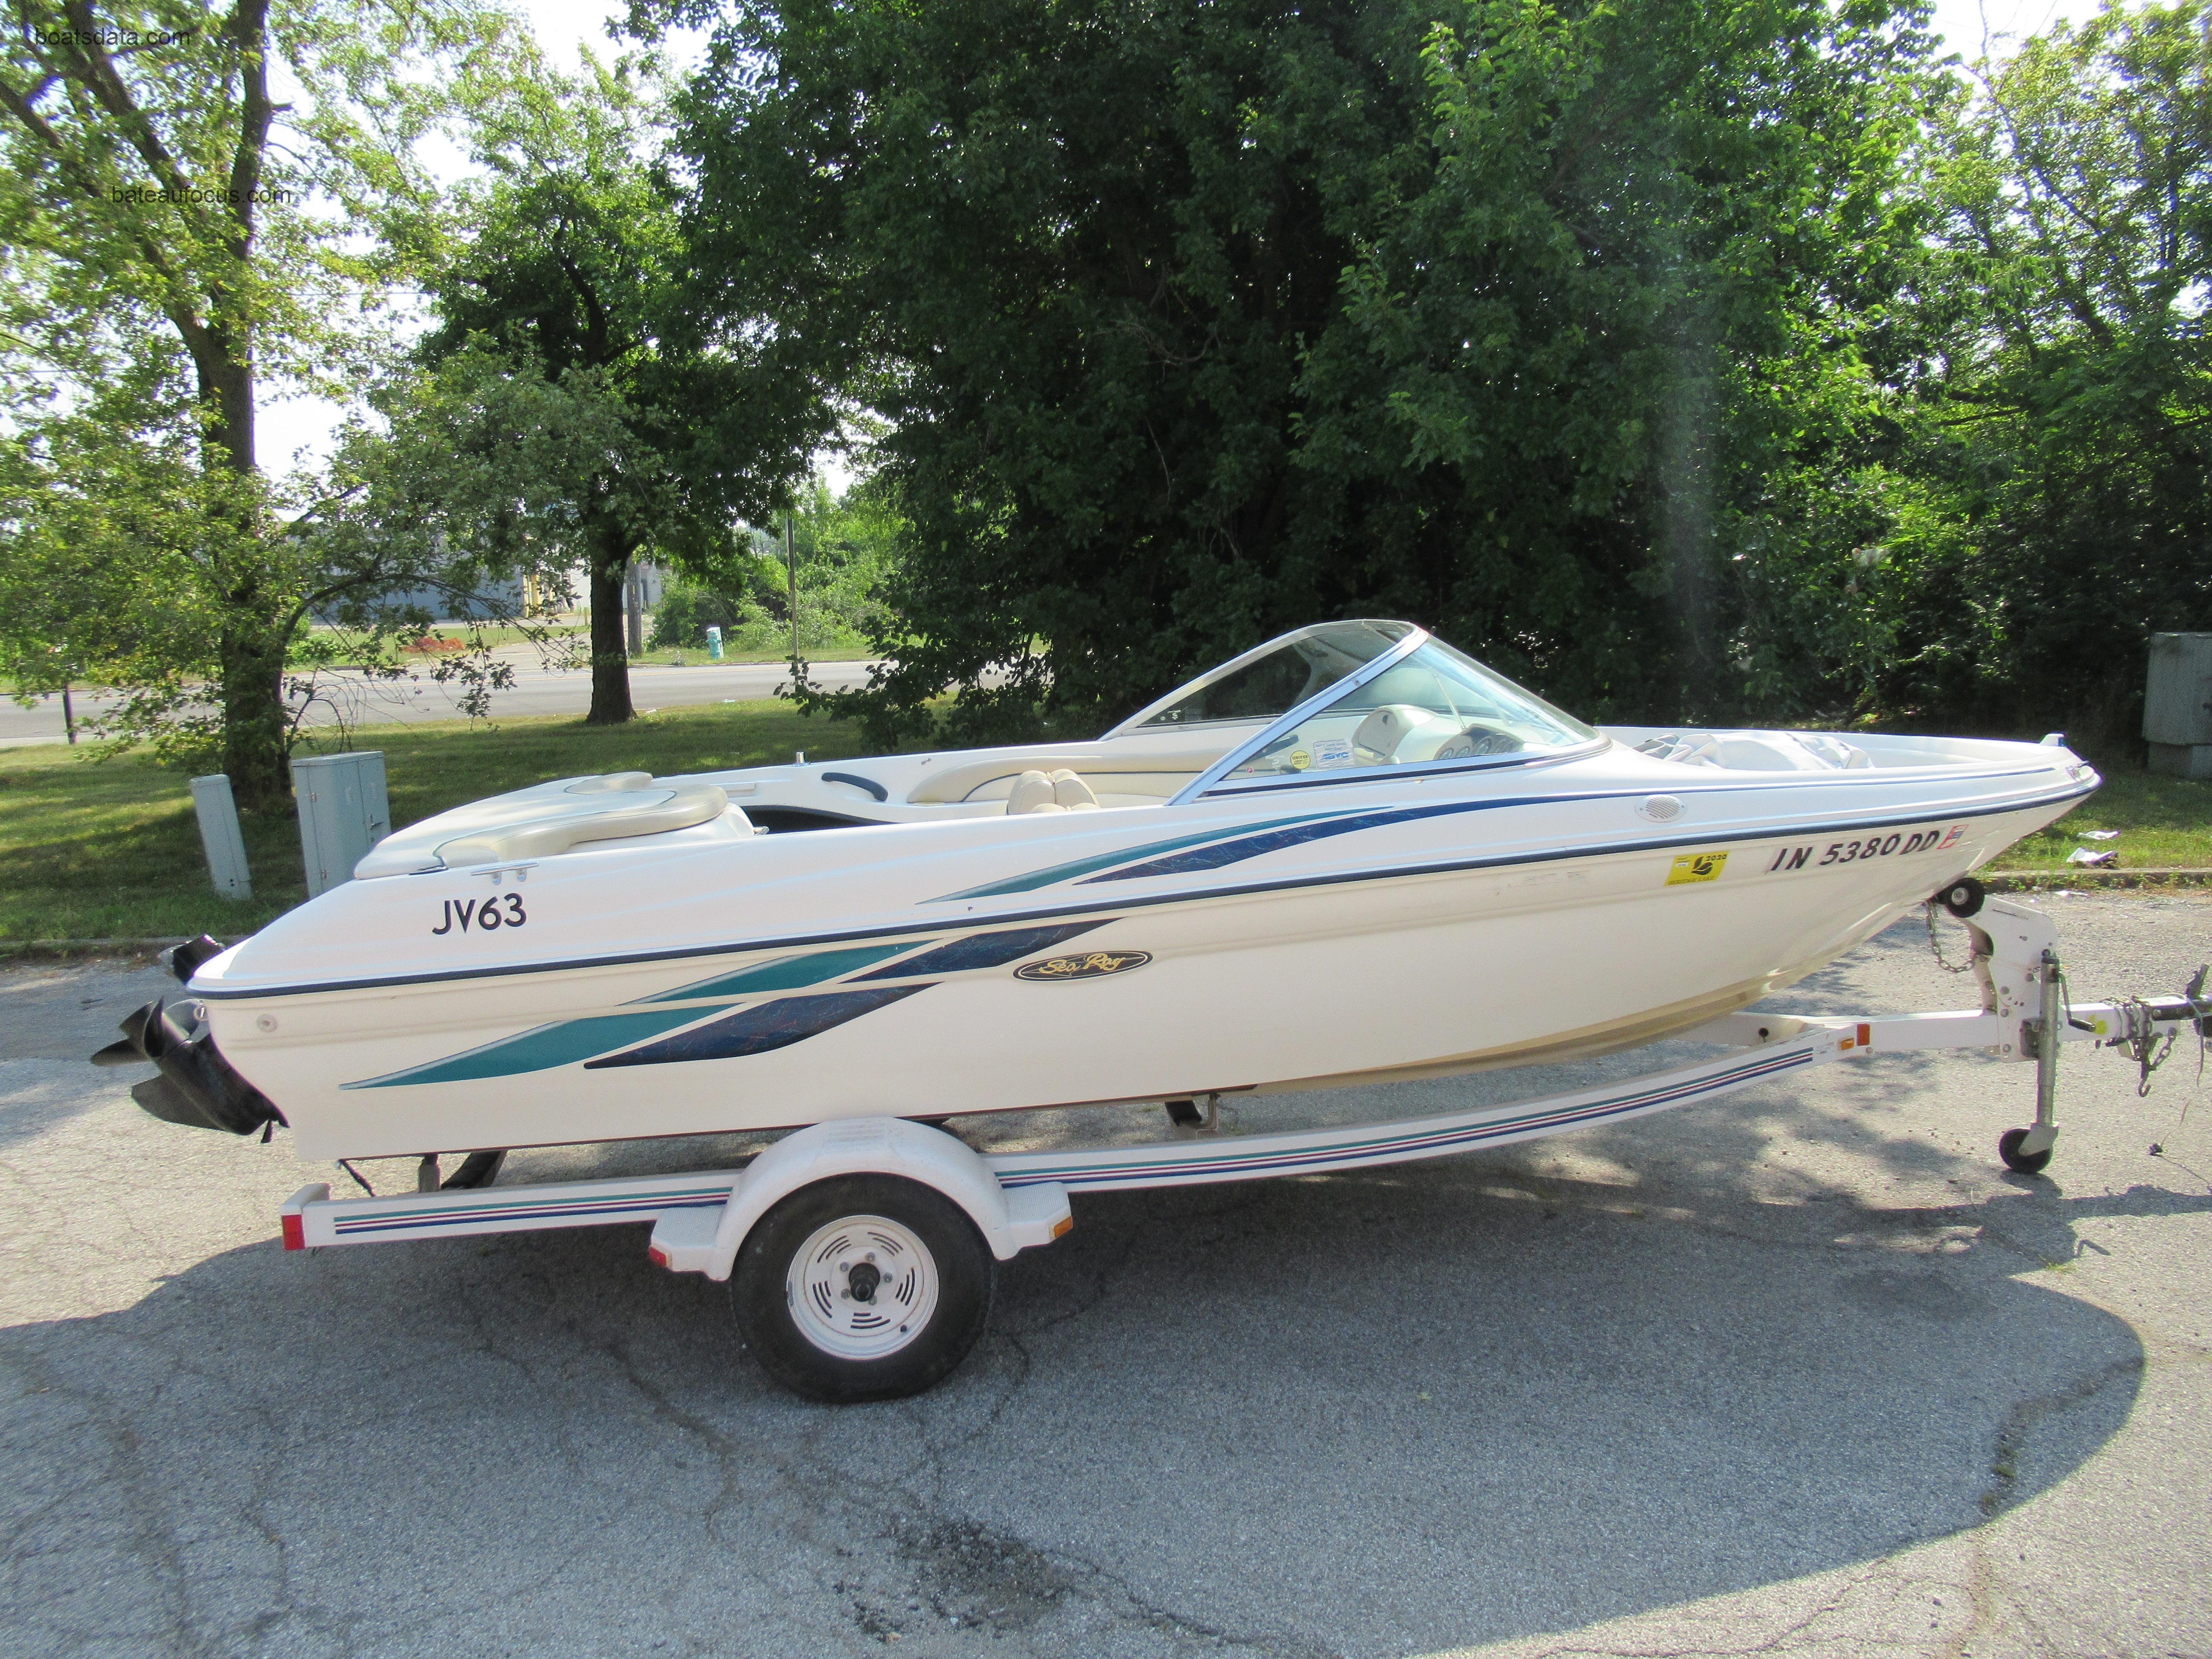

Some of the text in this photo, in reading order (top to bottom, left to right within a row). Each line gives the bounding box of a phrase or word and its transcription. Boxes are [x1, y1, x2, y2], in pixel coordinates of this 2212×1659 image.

[1771, 830, 1940, 871] IN 5380 DD
[432, 892, 527, 935] JV63
[1039, 953, 1126, 974] Sea Ray
